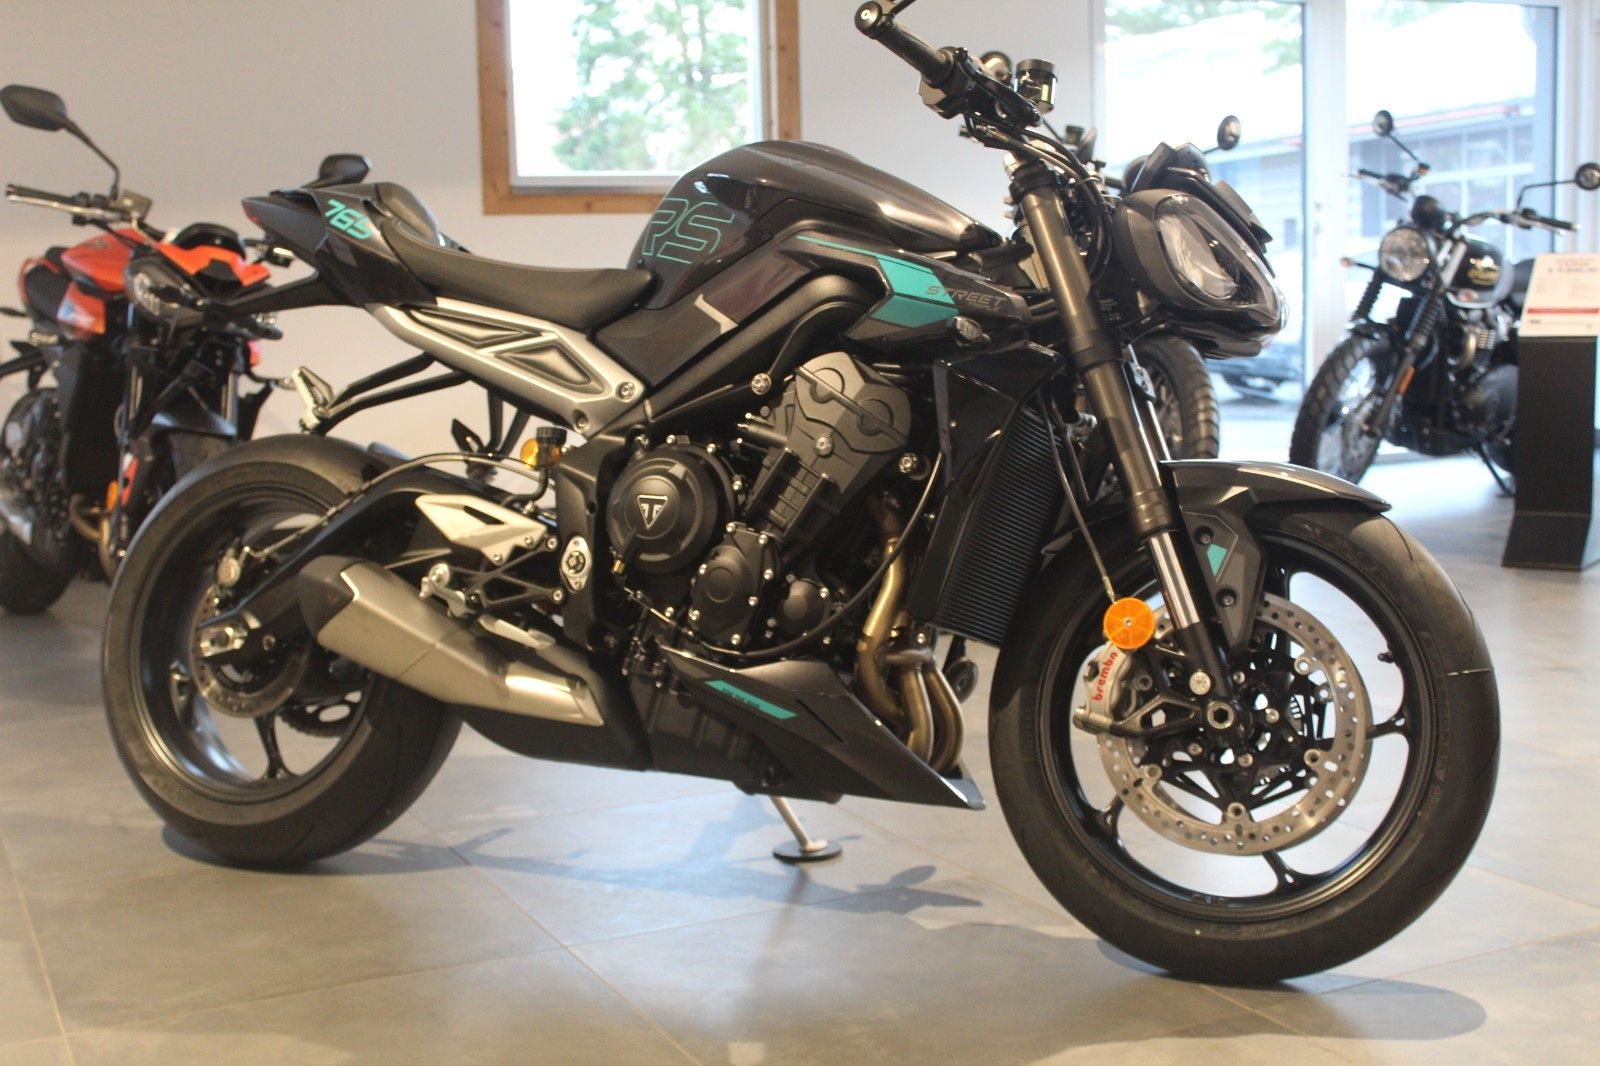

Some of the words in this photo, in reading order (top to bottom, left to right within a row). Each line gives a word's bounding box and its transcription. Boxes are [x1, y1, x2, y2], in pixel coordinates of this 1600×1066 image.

[324, 199, 373, 240] 765
[642, 197, 736, 264] RS
[926, 285, 1007, 307] STREET
